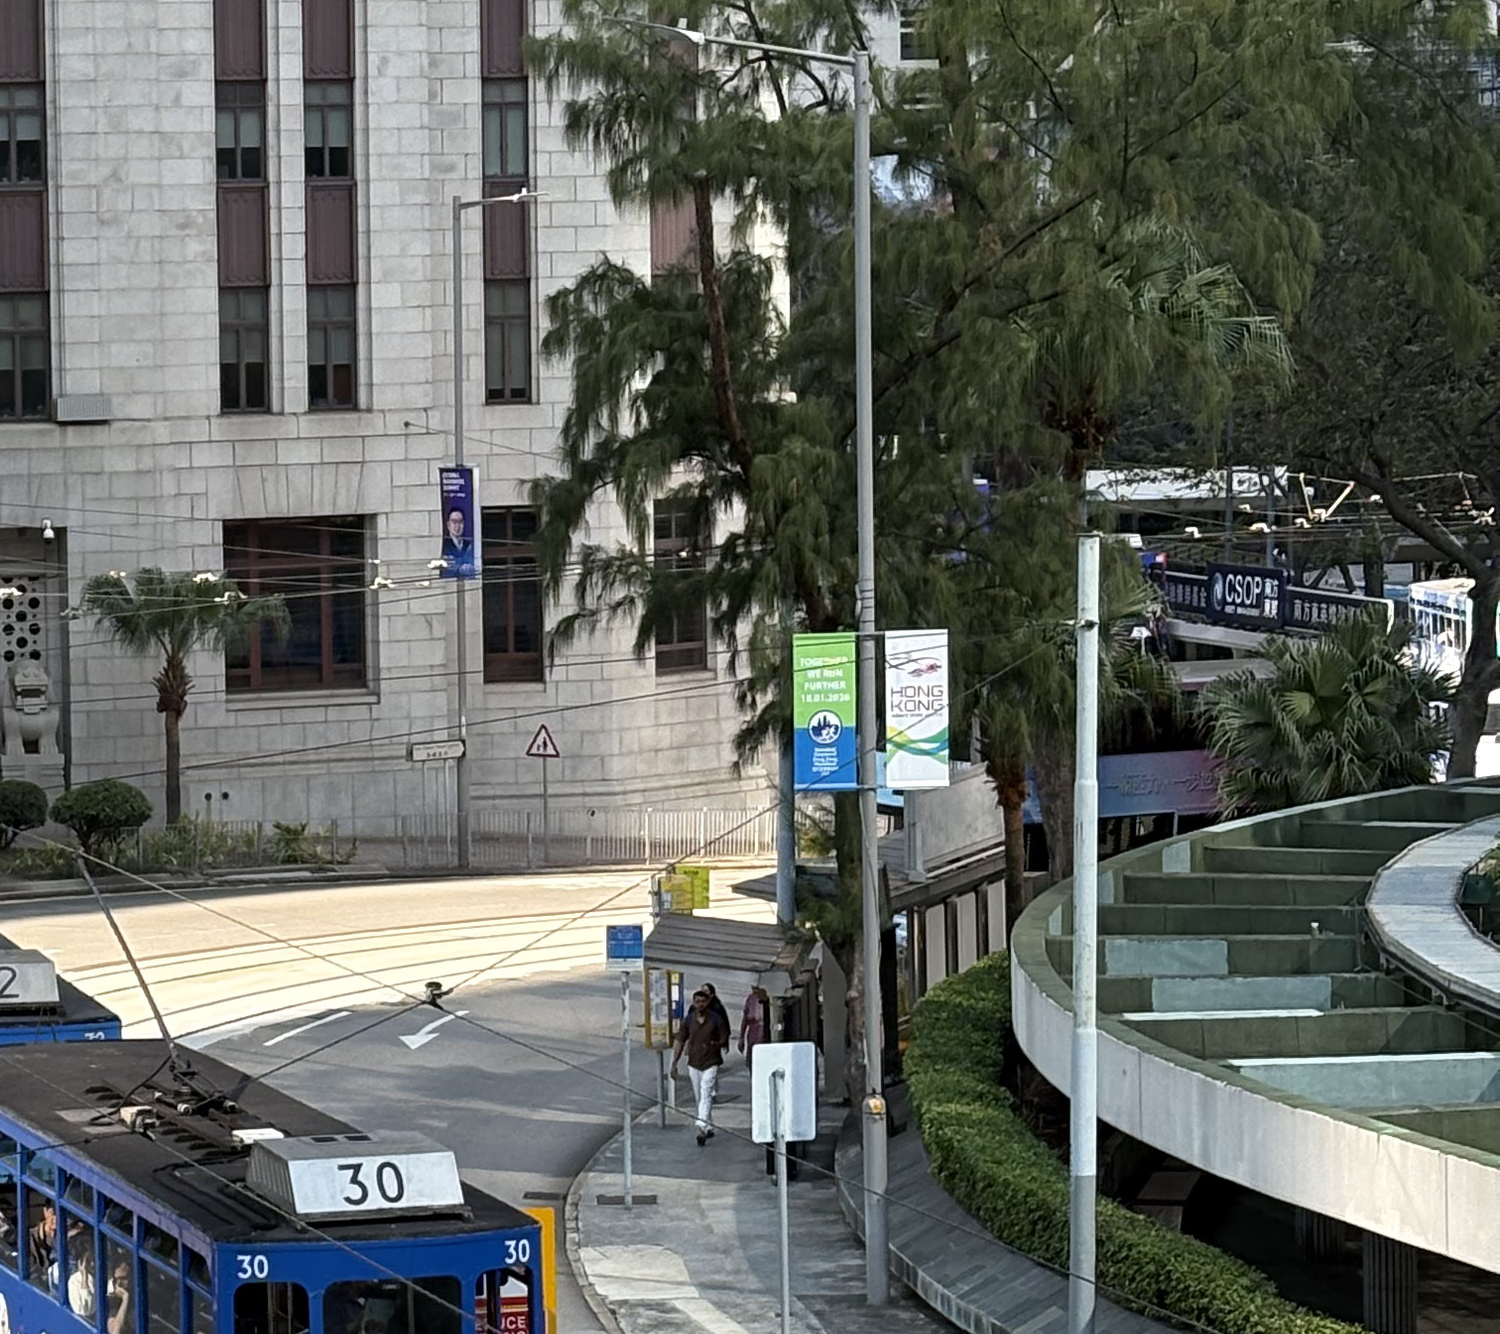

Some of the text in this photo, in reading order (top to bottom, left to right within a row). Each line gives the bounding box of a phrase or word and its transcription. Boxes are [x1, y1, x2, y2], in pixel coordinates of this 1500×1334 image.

[1224, 573, 1262, 606] CSOP
[804, 680, 847, 692] FURTHER
[890, 685, 944, 698] HONG
[890, 698, 944, 713] KONG
[337, 1161, 405, 1206] 30
[504, 1239, 531, 1264] 30
[236, 1254, 269, 1279] 30
